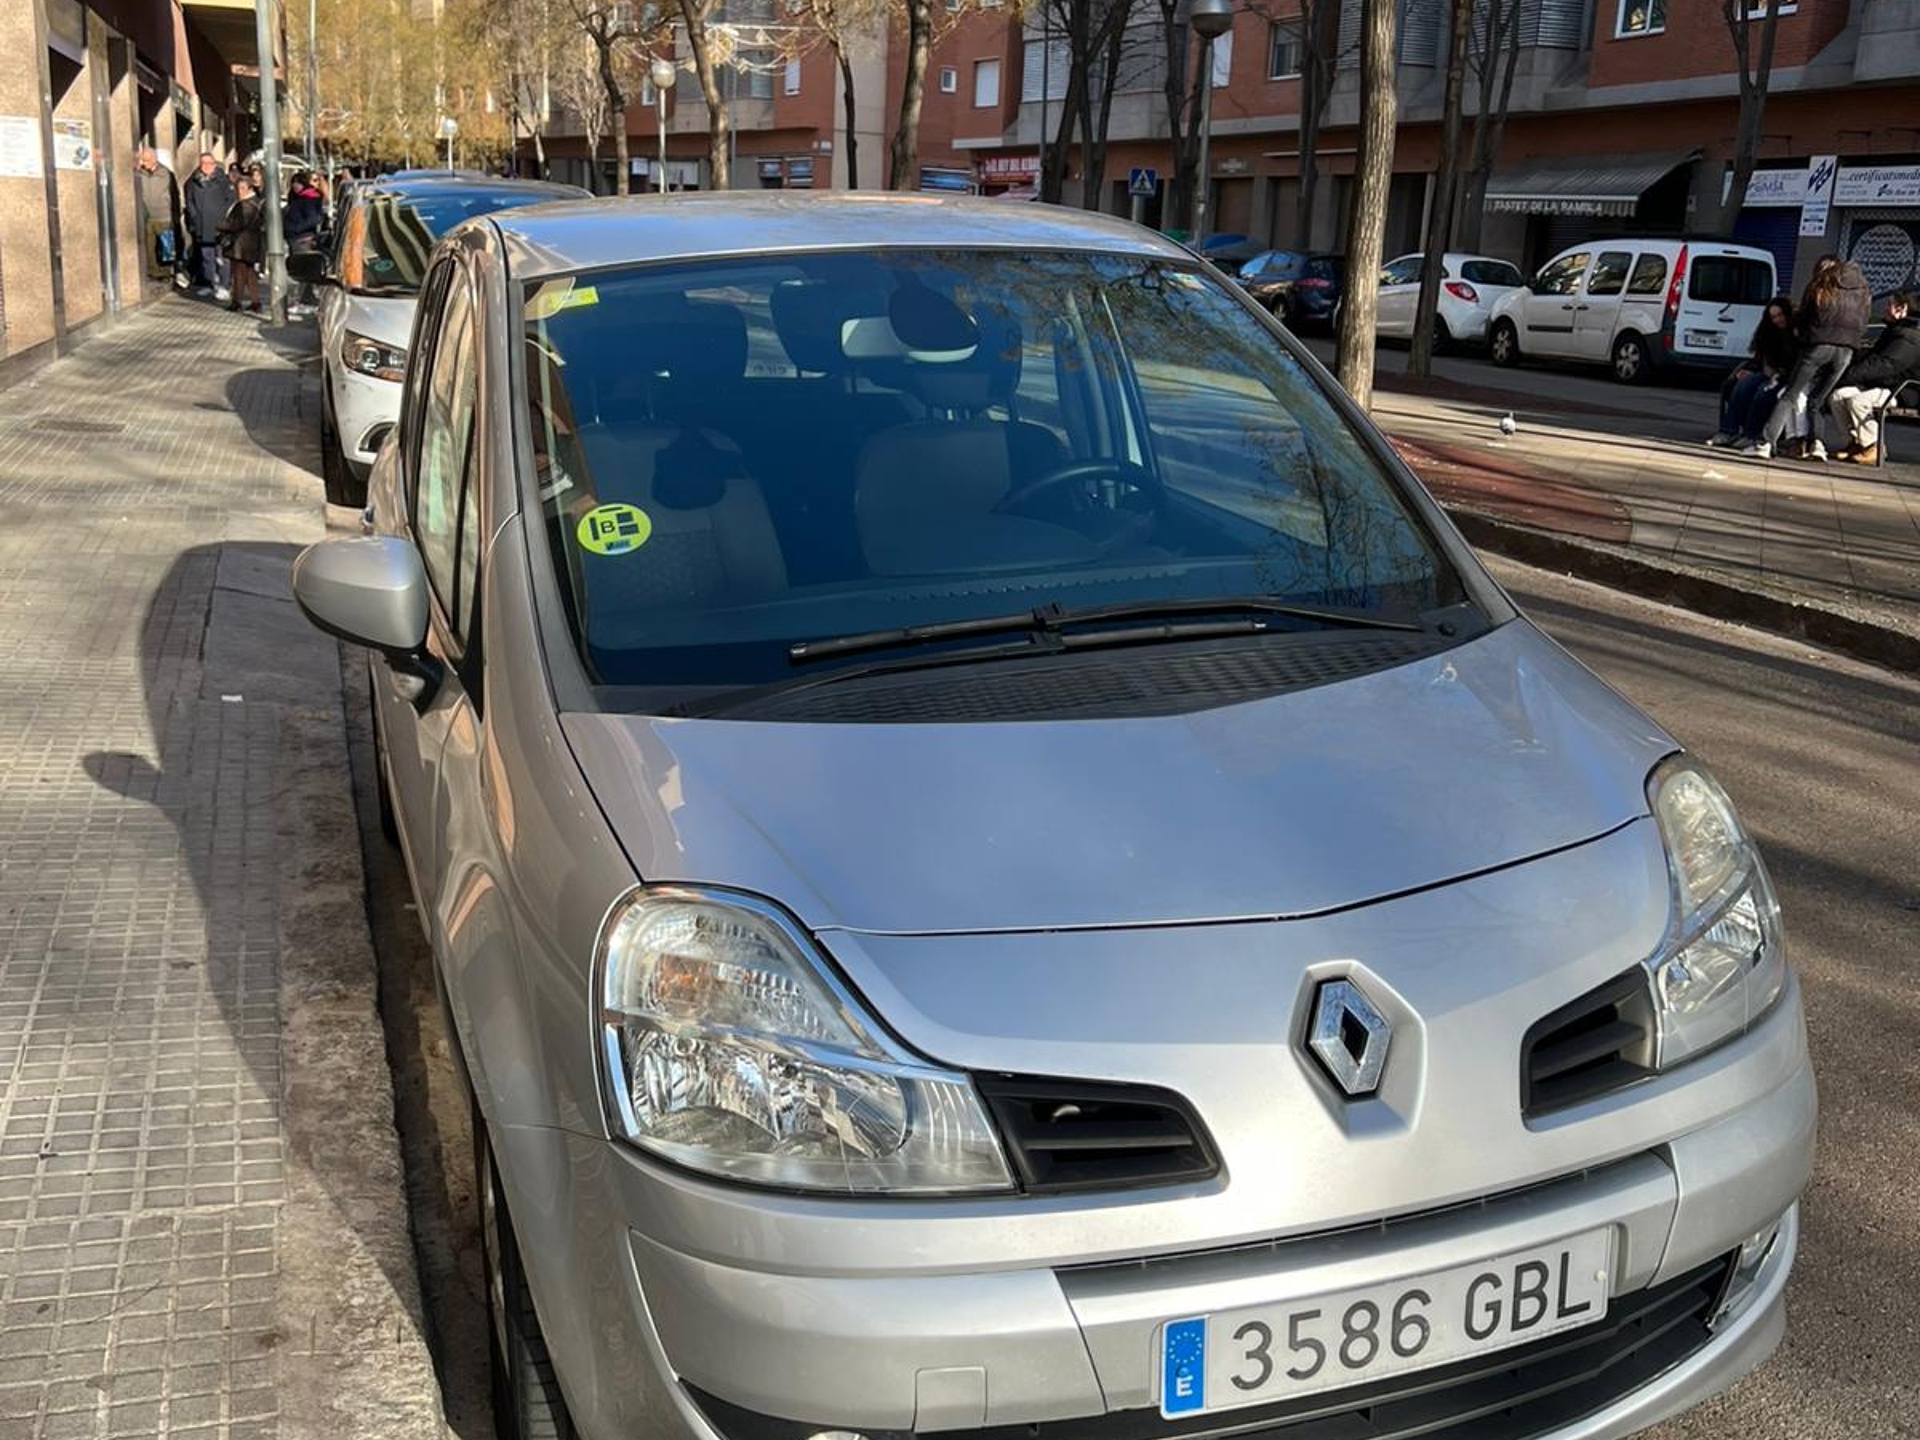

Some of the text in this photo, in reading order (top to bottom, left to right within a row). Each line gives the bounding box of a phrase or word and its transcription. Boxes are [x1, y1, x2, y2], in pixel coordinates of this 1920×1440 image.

[601, 520, 615, 534] B
[1230, 1251, 1591, 1391] 3586 GBL
[1176, 1375, 1193, 1396] E
